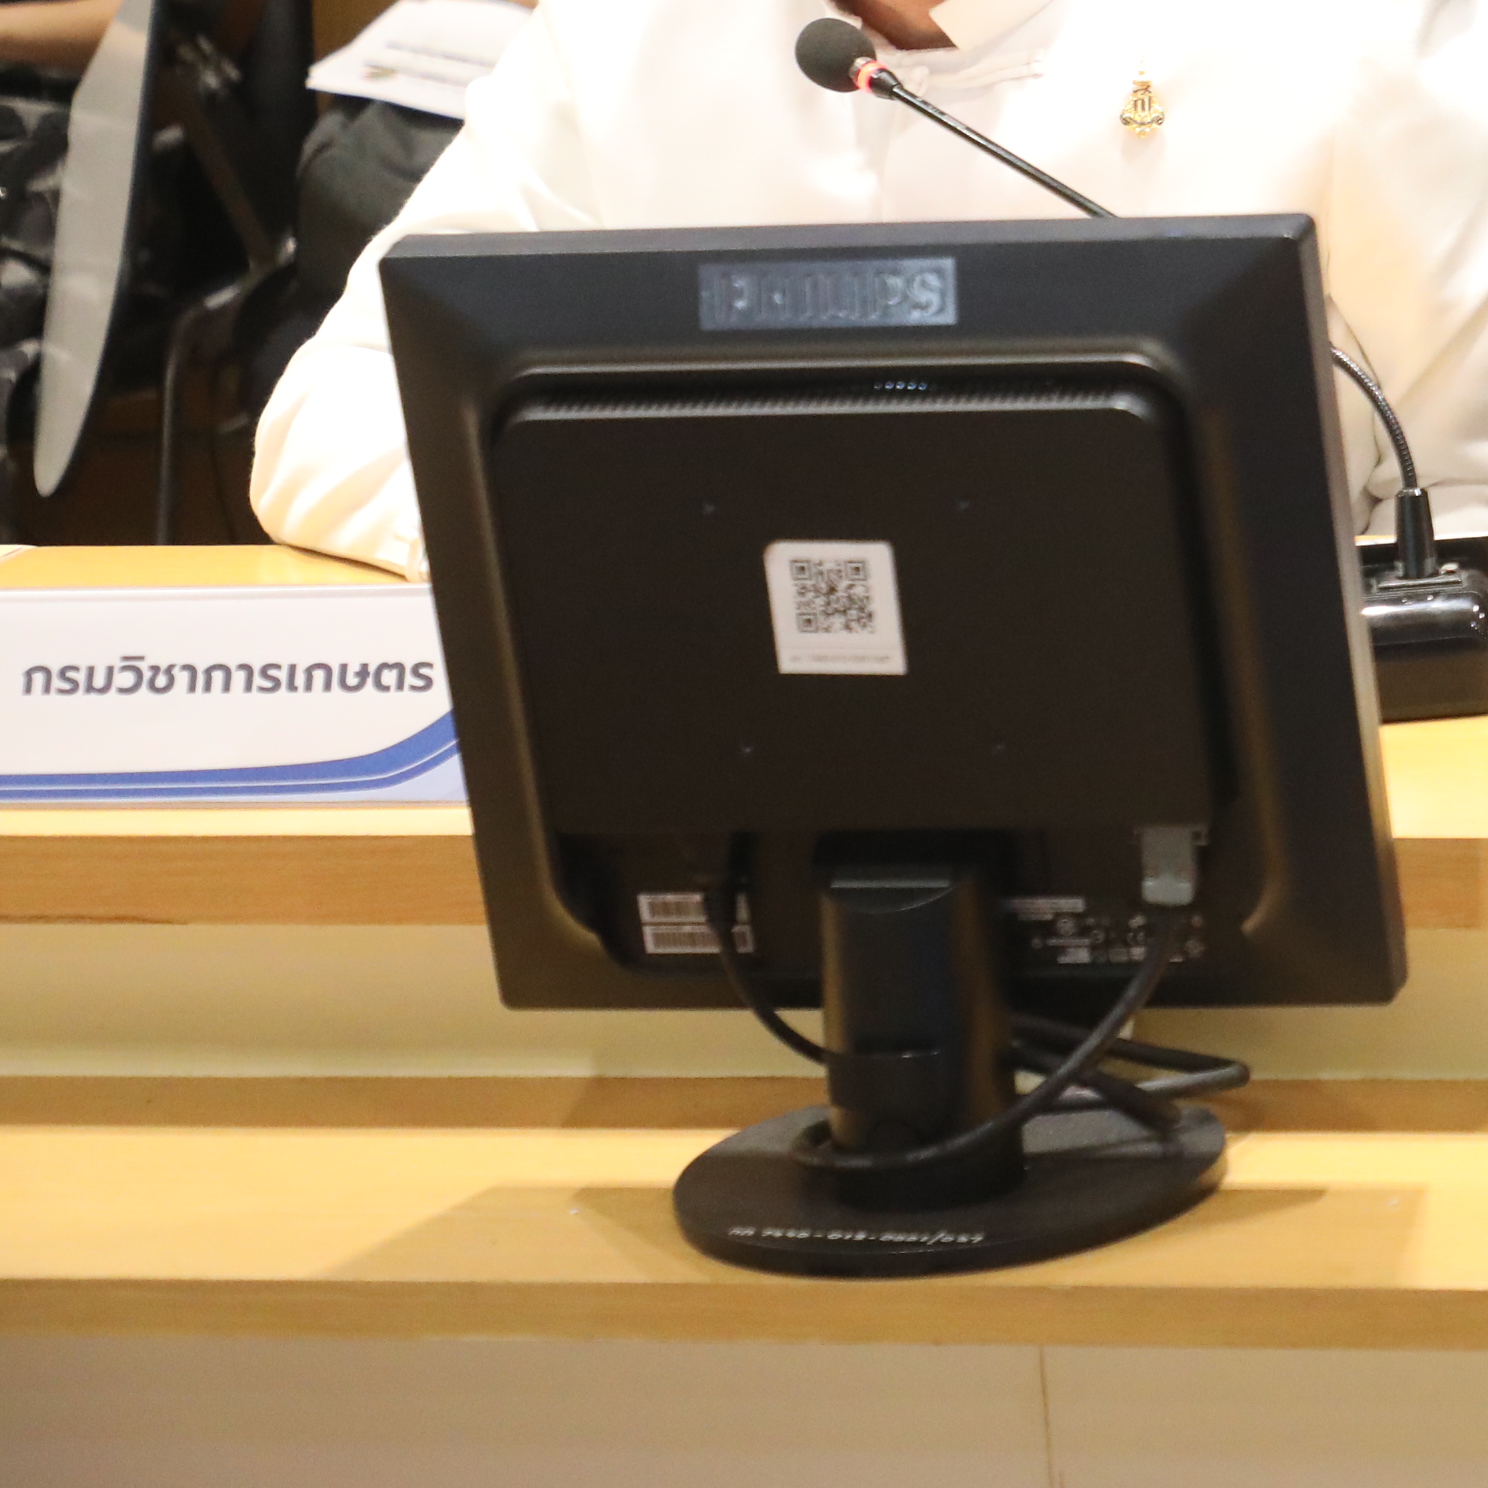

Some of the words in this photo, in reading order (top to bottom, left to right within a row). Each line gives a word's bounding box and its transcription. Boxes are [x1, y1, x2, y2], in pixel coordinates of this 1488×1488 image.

[22, 655, 434, 696] กรมวิชาการเกษตร
